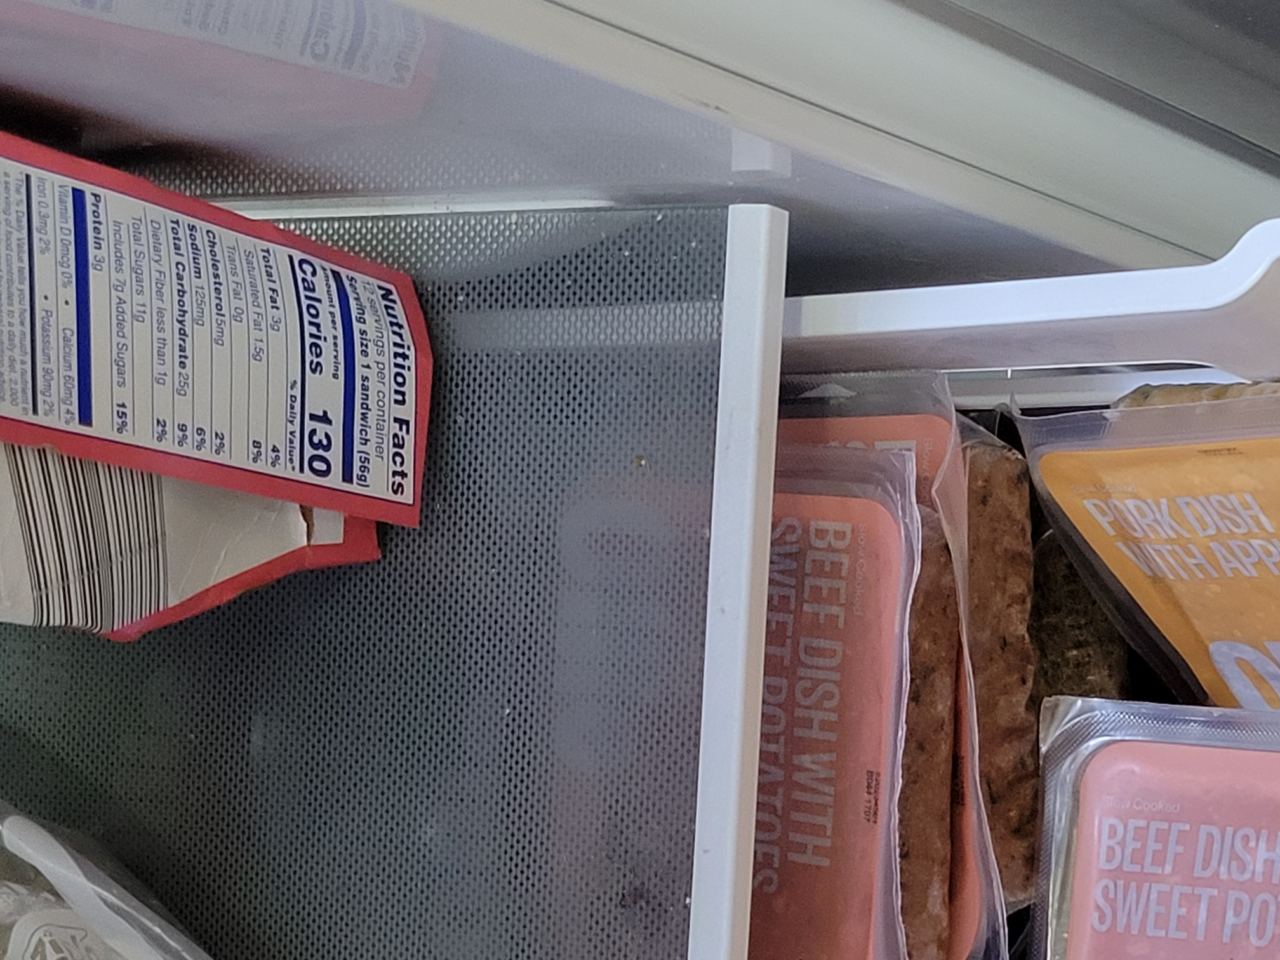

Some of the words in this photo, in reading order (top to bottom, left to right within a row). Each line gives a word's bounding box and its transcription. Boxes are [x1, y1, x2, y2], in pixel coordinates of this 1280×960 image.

[37, 177, 49, 199] Iron
[58, 185, 71, 224] Vitamin
[35, 201, 49, 236] 0.3mg
[60, 226, 71, 237] D
[90, 192, 105, 250] Protein
[131, 216, 144, 247] Total
[58, 238, 72, 270] 0mcg
[113, 220, 124, 275] Includes
[150, 219, 163, 267] Dietary
[170, 219, 185, 257] Total
[187, 223, 202, 280] Sodium
[91, 254, 105, 272] 3g
[132, 249, 146, 296] Sugars
[205, 229, 226, 318] Cholesterol
[226, 245, 239, 278] Trans
[260, 247, 276, 284] Total
[112, 278, 126, 293] 7g
[155, 269, 166, 304] Fiber
[232, 281, 243, 301] Fat
[244, 250, 263, 309] Saturated
[320, 264, 336, 309] Amount
[361, 280, 374, 294] 12
[134, 302, 147, 323] 11g
[175, 261, 189, 370] Carbohydrate
[194, 285, 206, 327] 125mg
[233, 306, 245, 323] 0g
[269, 286, 281, 311] Fat
[346, 275, 366, 325] Serving
[115, 295, 127, 339] Added
[156, 306, 167, 334] less
[253, 312, 264, 332] Fat
[269, 317, 282, 332] 3g
[297, 258, 329, 376] Calories
[328, 311, 337, 332] per
[366, 296, 385, 357] servings
[41, 308, 53, 365] Potassium
[62, 327, 75, 372] Calcium
[157, 337, 168, 367] than
[252, 338, 265, 363] 1.5g
[358, 329, 369, 357] size
[377, 285, 411, 406] Nutrition
[114, 341, 128, 389] Sugars
[332, 334, 342, 381] serving
[374, 361, 386, 387] per
[40, 367, 54, 398] 90mg
[61, 374, 75, 406] 60mg
[155, 371, 168, 386] 1g
[176, 372, 190, 397] 25g
[289, 379, 297, 392] %
[43, 399, 55, 418] 2%
[64, 408, 75, 426] 4%
[116, 402, 128, 435] 15%
[287, 394, 297, 428] Daily
[359, 375, 371, 446] sandwich
[374, 390, 387, 462] container
[156, 417, 168, 443] 2%
[177, 423, 188, 448] 9%
[195, 427, 206, 452] 6%
[215, 431, 225, 456] 2%
[308, 409, 333, 478] 130
[252, 439, 263, 464] 8%
[270, 444, 281, 468] 4%
[356, 450, 370, 488] (56g)
[391, 416, 411, 496] Facts
[1083, 497, 1191, 542] PORK
[1175, 491, 1275, 539] DISH
[803, 520, 852, 629] BEEF
[1115, 540, 1218, 581] WITH
[764, 517, 801, 667] SWEET
[794, 637, 843, 741] DISH
[752, 674, 788, 895] POTATOES
[787, 750, 837, 867] WITH
[1133, 798, 1180, 813] Cooked
[1100, 817, 1190, 875] BEEF
[1091, 879, 1219, 941] SWEET
